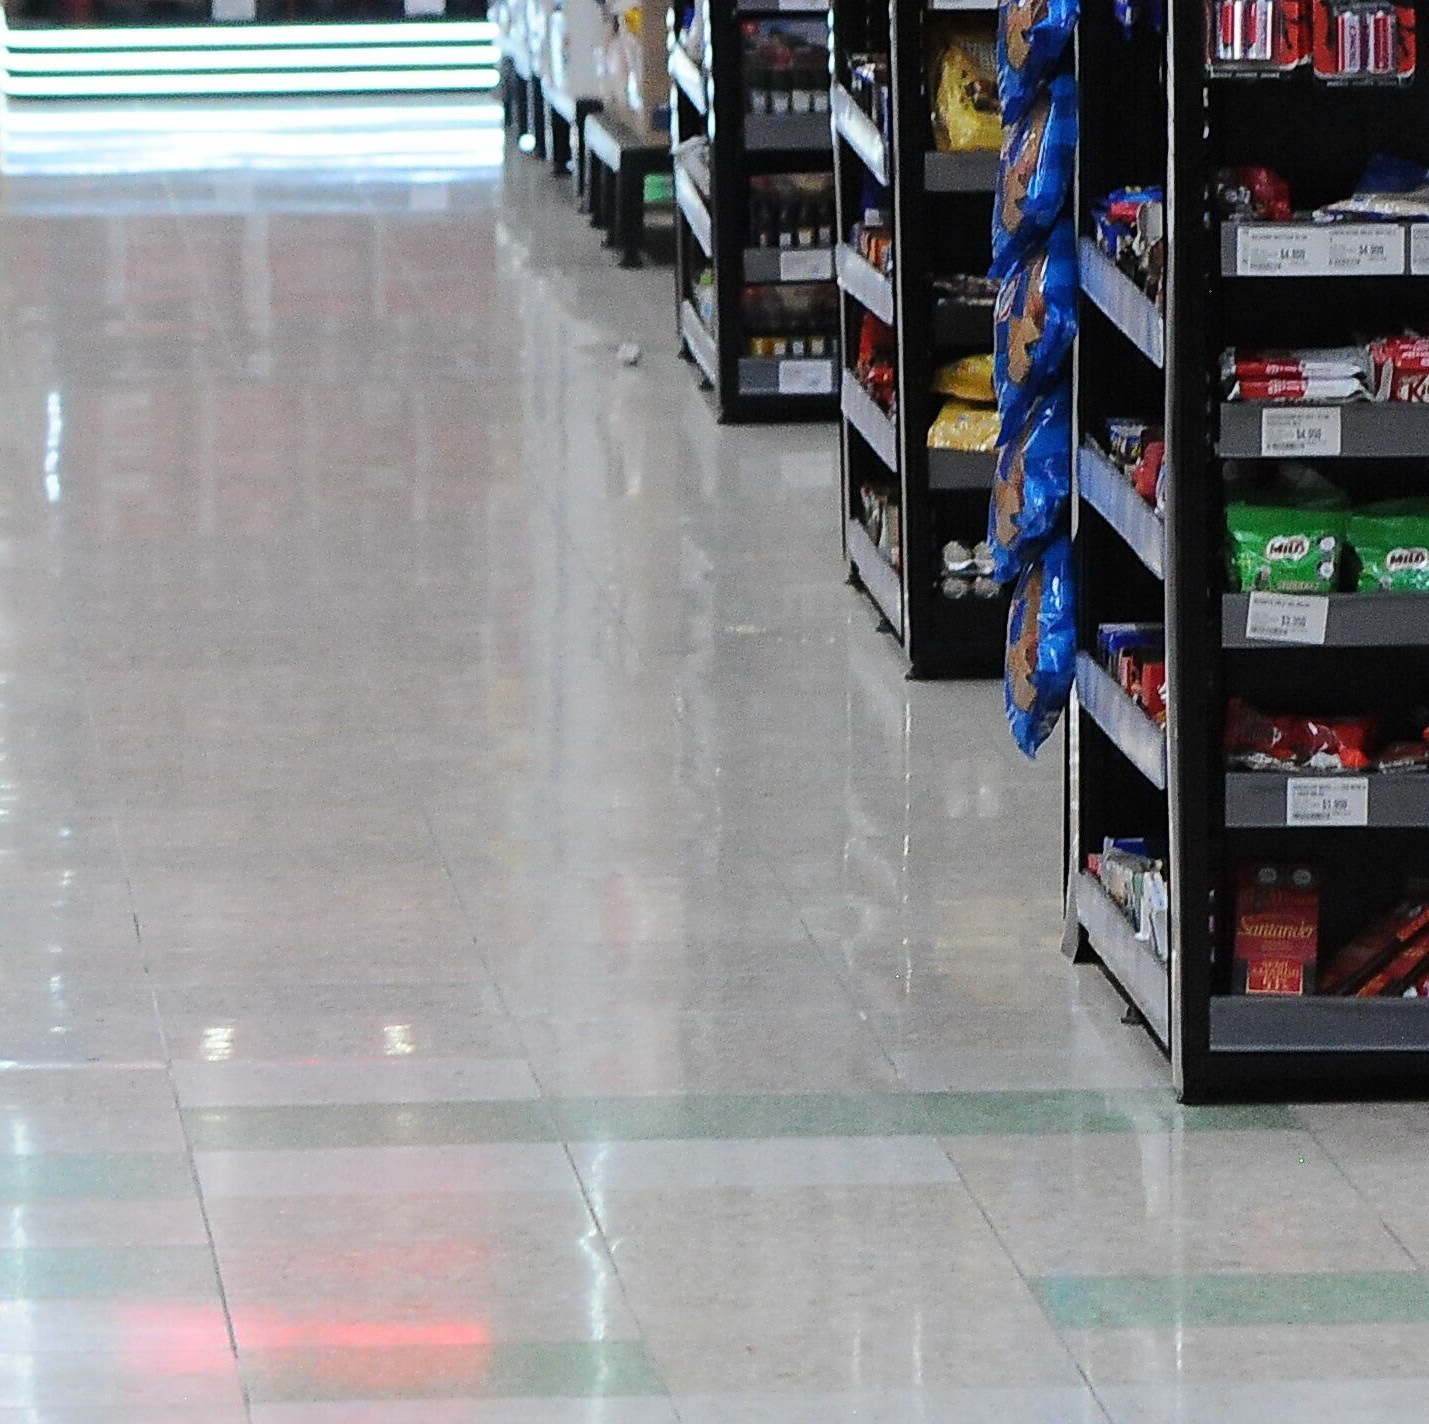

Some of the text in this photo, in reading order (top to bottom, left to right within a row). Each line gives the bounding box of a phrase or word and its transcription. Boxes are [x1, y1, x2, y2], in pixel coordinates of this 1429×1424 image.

[1269, 540, 1306, 555] MILO
[1390, 551, 1426, 565] MILO
[1238, 915, 1314, 940] Santander
